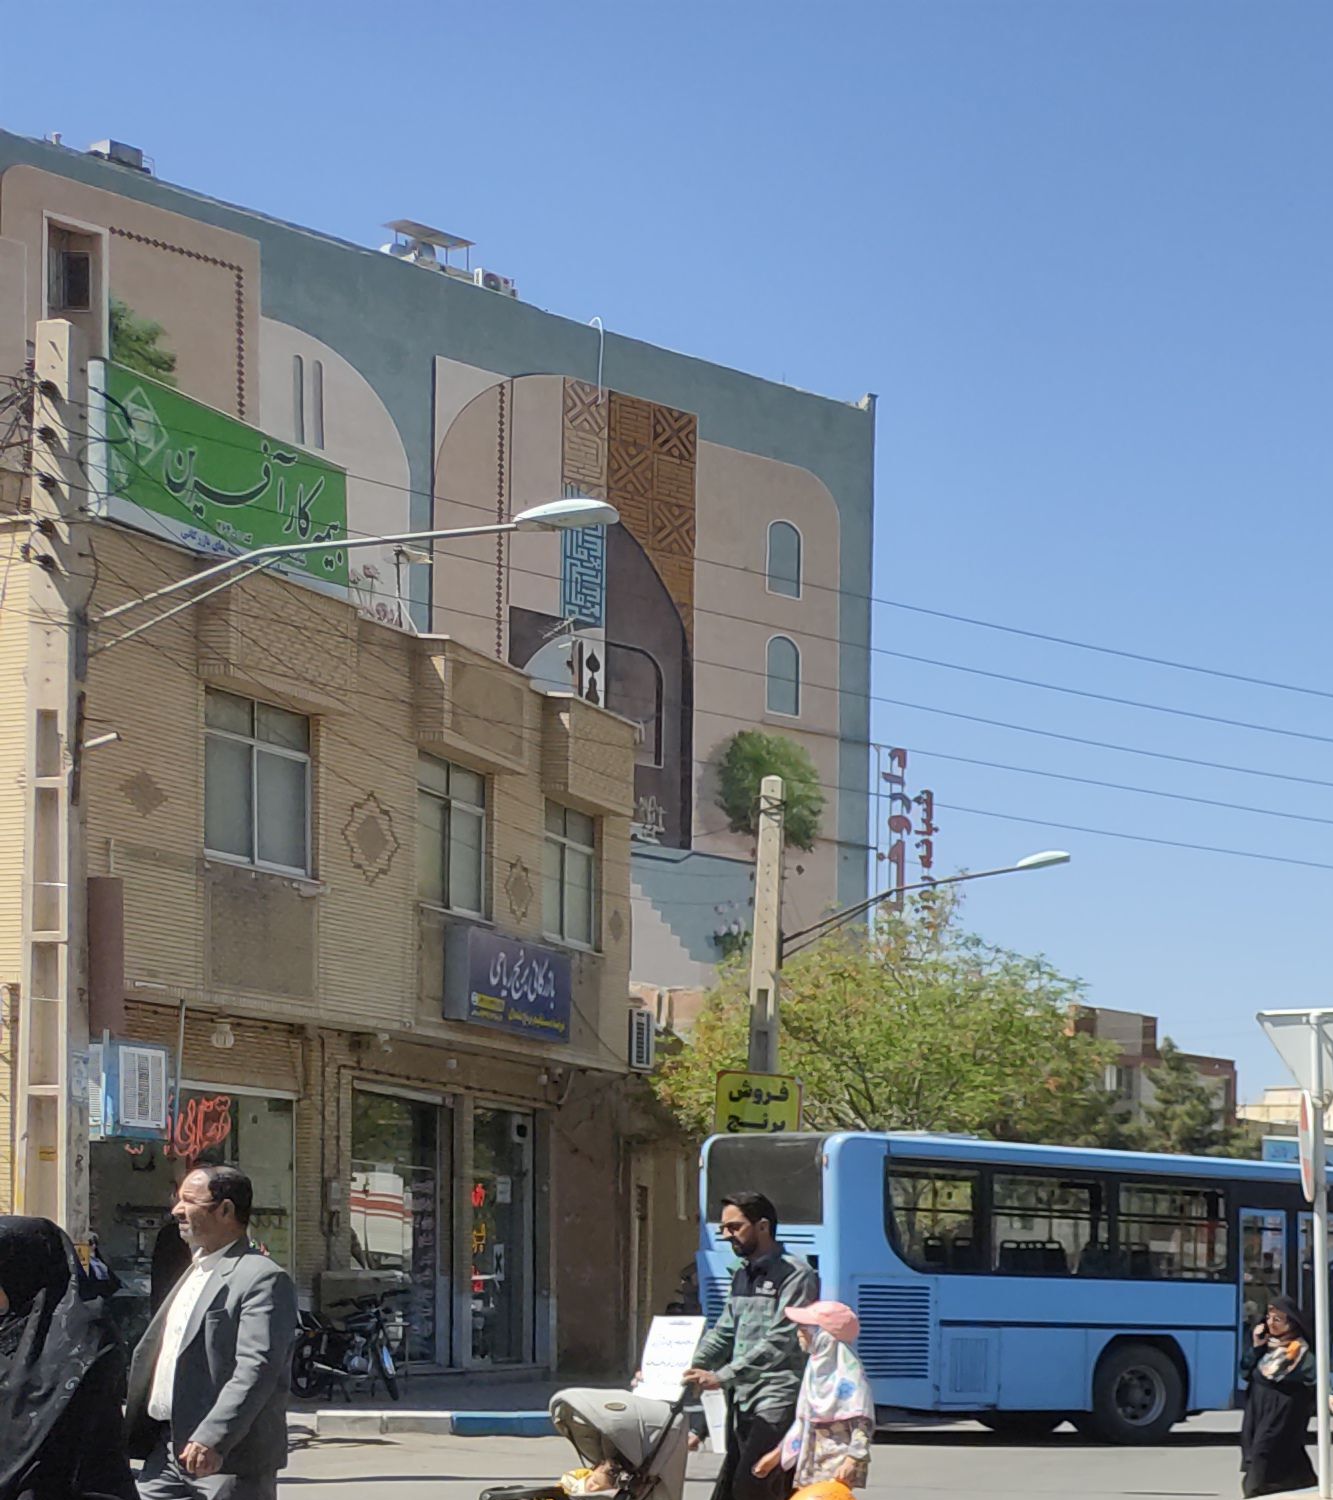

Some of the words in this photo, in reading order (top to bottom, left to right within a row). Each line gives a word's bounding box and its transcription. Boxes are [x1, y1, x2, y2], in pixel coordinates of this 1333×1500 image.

[876, 747, 912, 914] داروخا
[728, 1079, 789, 1105] فروش
[726, 1112, 786, 1134] برنج
